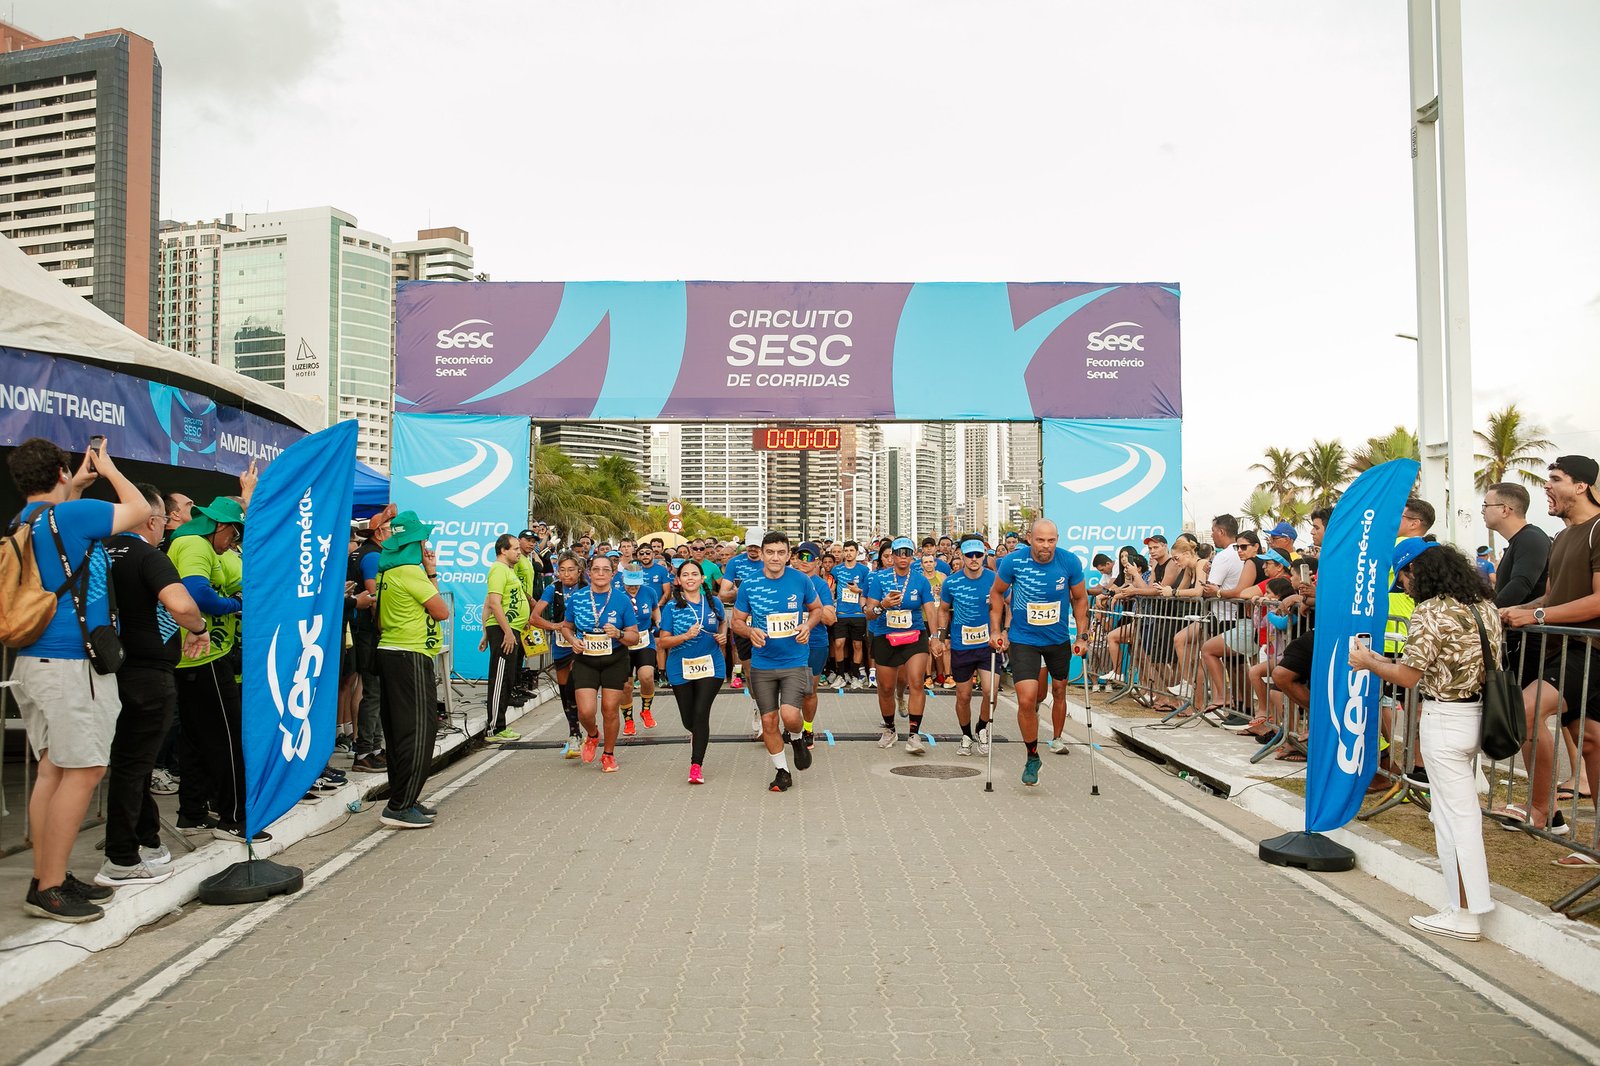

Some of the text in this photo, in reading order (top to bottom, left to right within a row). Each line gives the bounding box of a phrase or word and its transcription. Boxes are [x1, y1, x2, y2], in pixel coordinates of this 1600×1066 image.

[729, 309, 853, 328] CIRCUITO
[435, 326, 494, 349] Sesc
[1086, 329, 1145, 352] Sesc
[726, 334, 853, 367] SESC
[435, 354, 494, 365] Fecomércio
[1086, 357, 1145, 368] Fecomércio
[292, 362, 320, 371] LUZEIROS
[435, 368, 468, 377] Senac
[726, 373, 851, 387] DE CORRIDAS
[1086, 370, 1119, 379] Senac
[183, 424, 203, 438] SESC
[766, 429, 839, 449] 0:00:00
[669, 503, 681, 511] 40
[420, 519, 509, 537] RCUITO
[425, 540, 497, 568] ESC
[1351, 508, 1376, 616] Fecomércio
[1364, 558, 1378, 617] Senac
[891, 615, 907, 624] 714
[1031, 608, 1057, 620] 2542
[772, 620, 797, 632] 1188
[965, 630, 987, 640] 1644
[585, 641, 609, 650] 1888
[688, 663, 708, 674] 396
